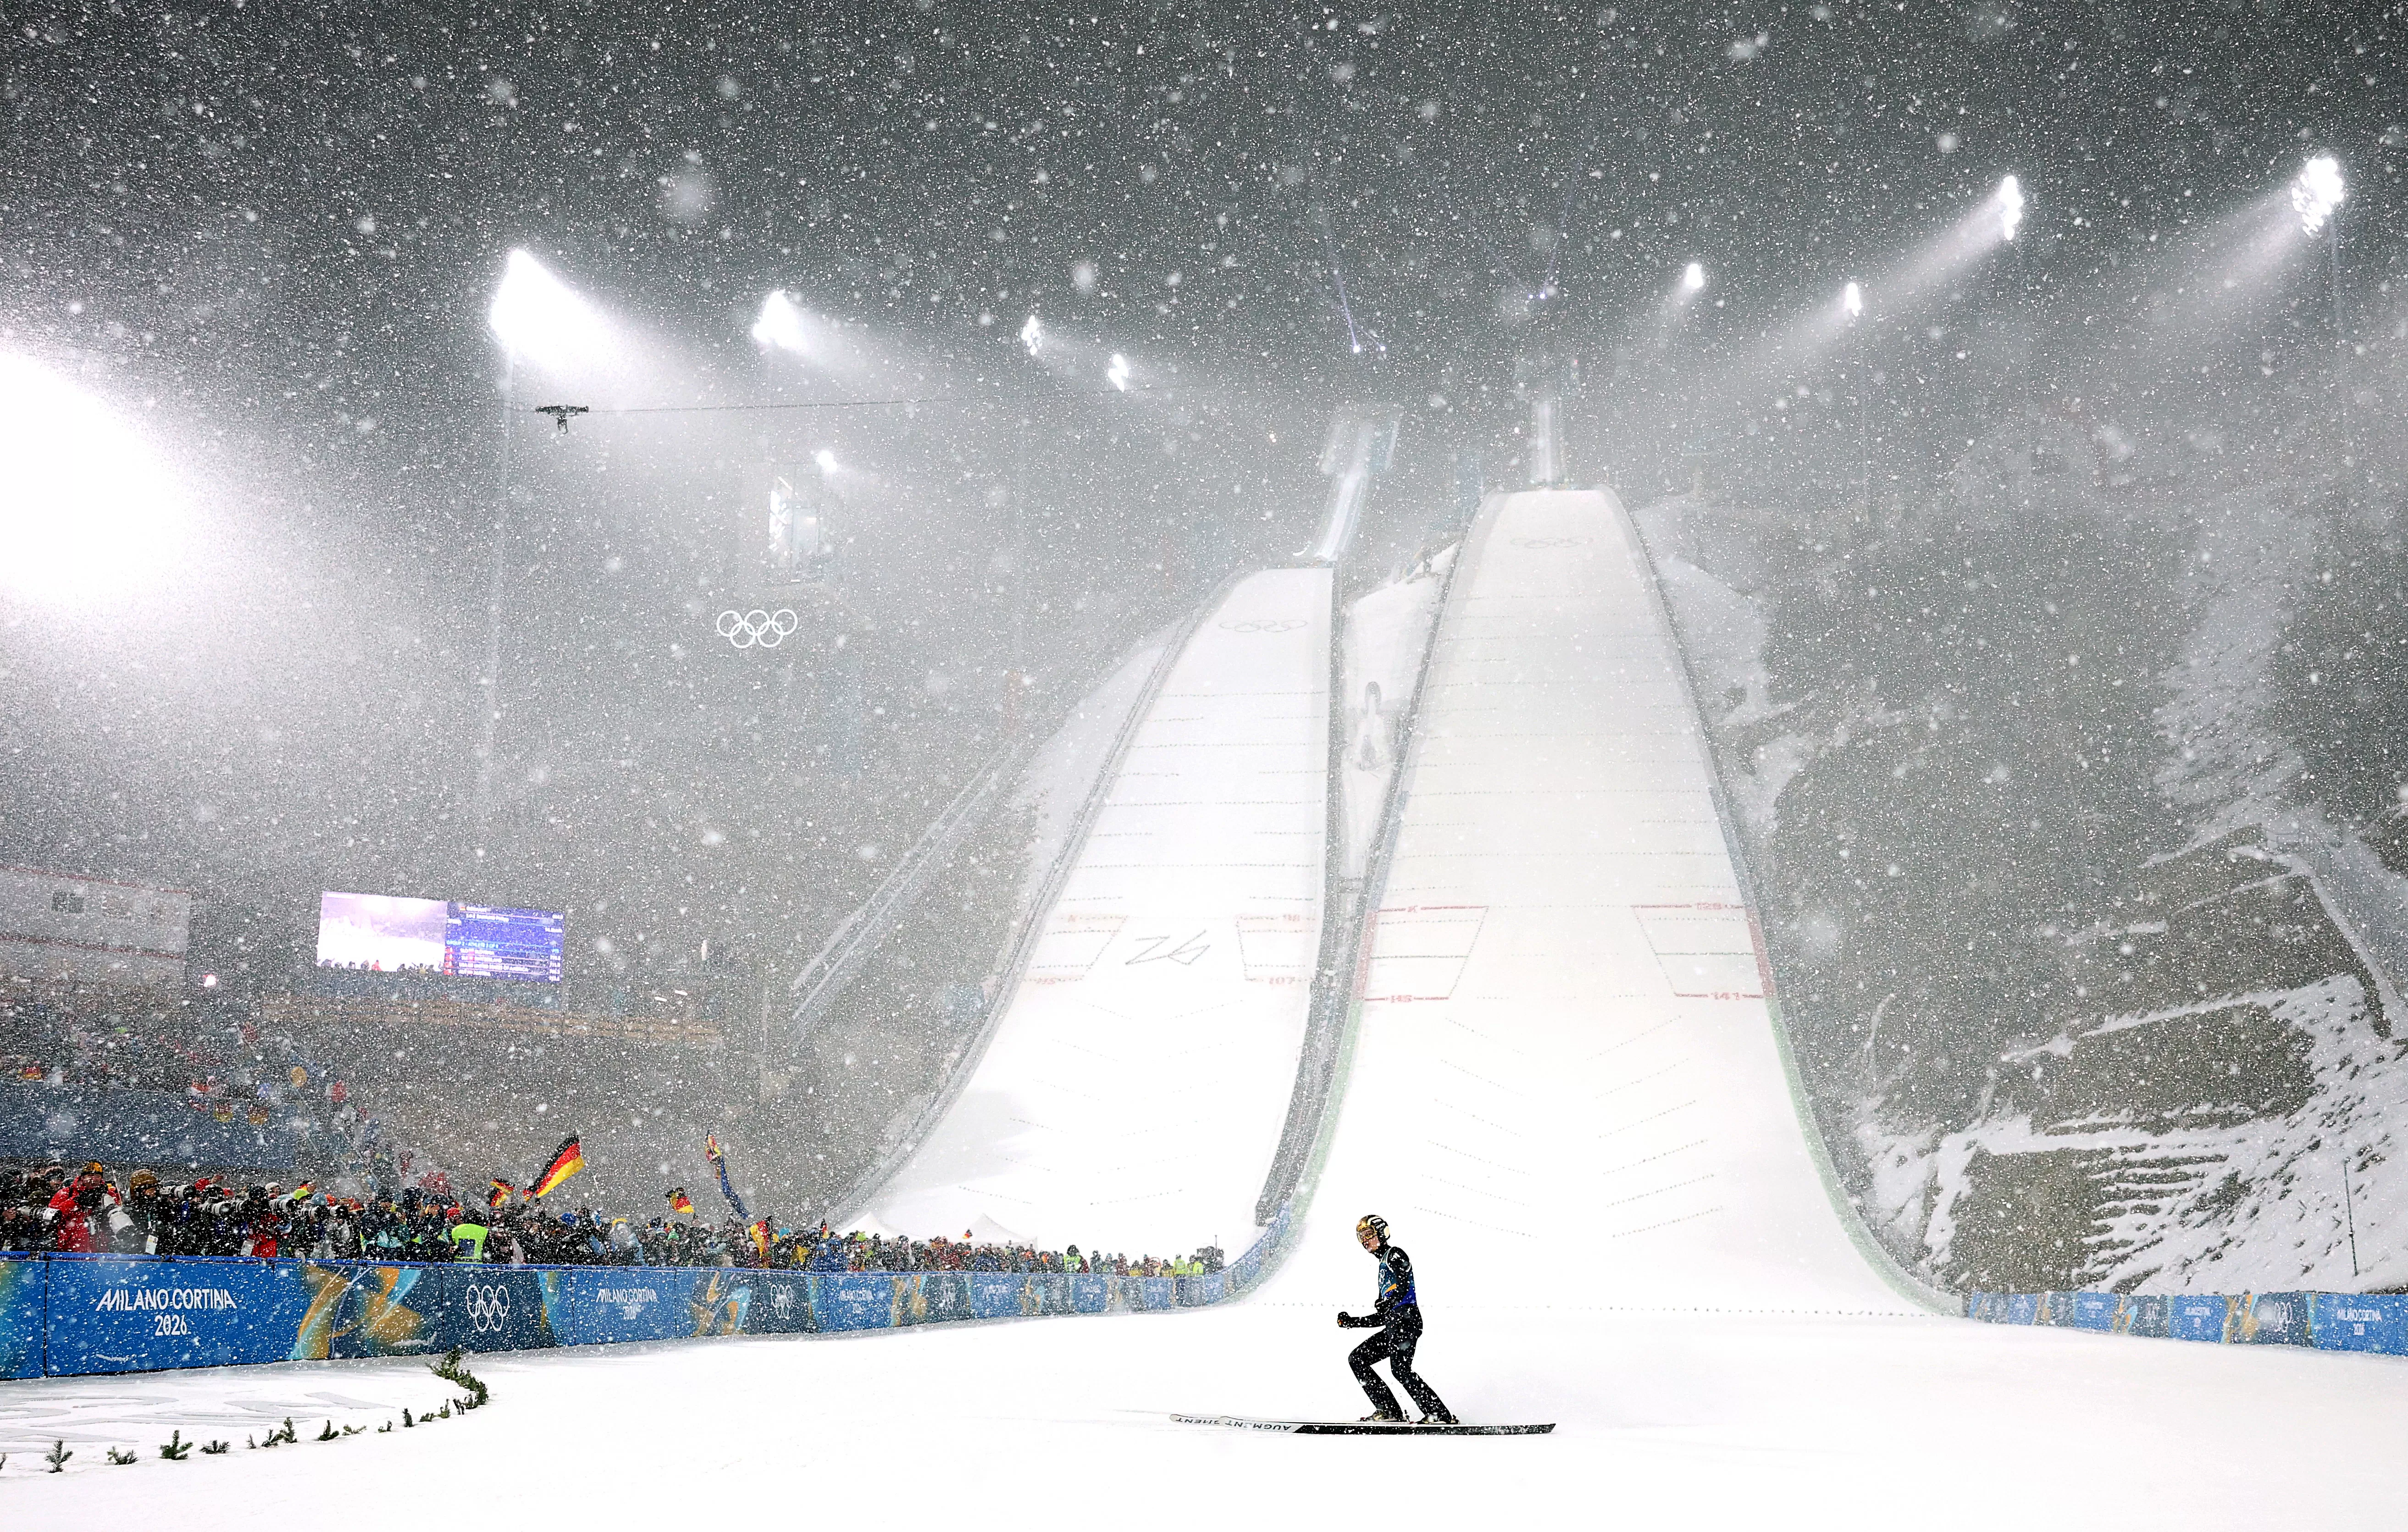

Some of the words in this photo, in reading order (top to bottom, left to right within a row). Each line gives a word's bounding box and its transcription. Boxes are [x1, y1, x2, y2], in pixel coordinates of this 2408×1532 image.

[95, 1288, 169, 1311] MILANO
[172, 1288, 238, 1309] CORTINA
[596, 1288, 627, 1303] MILANO
[628, 1288, 659, 1303] CORTINA
[155, 1314, 188, 1336] 2026
